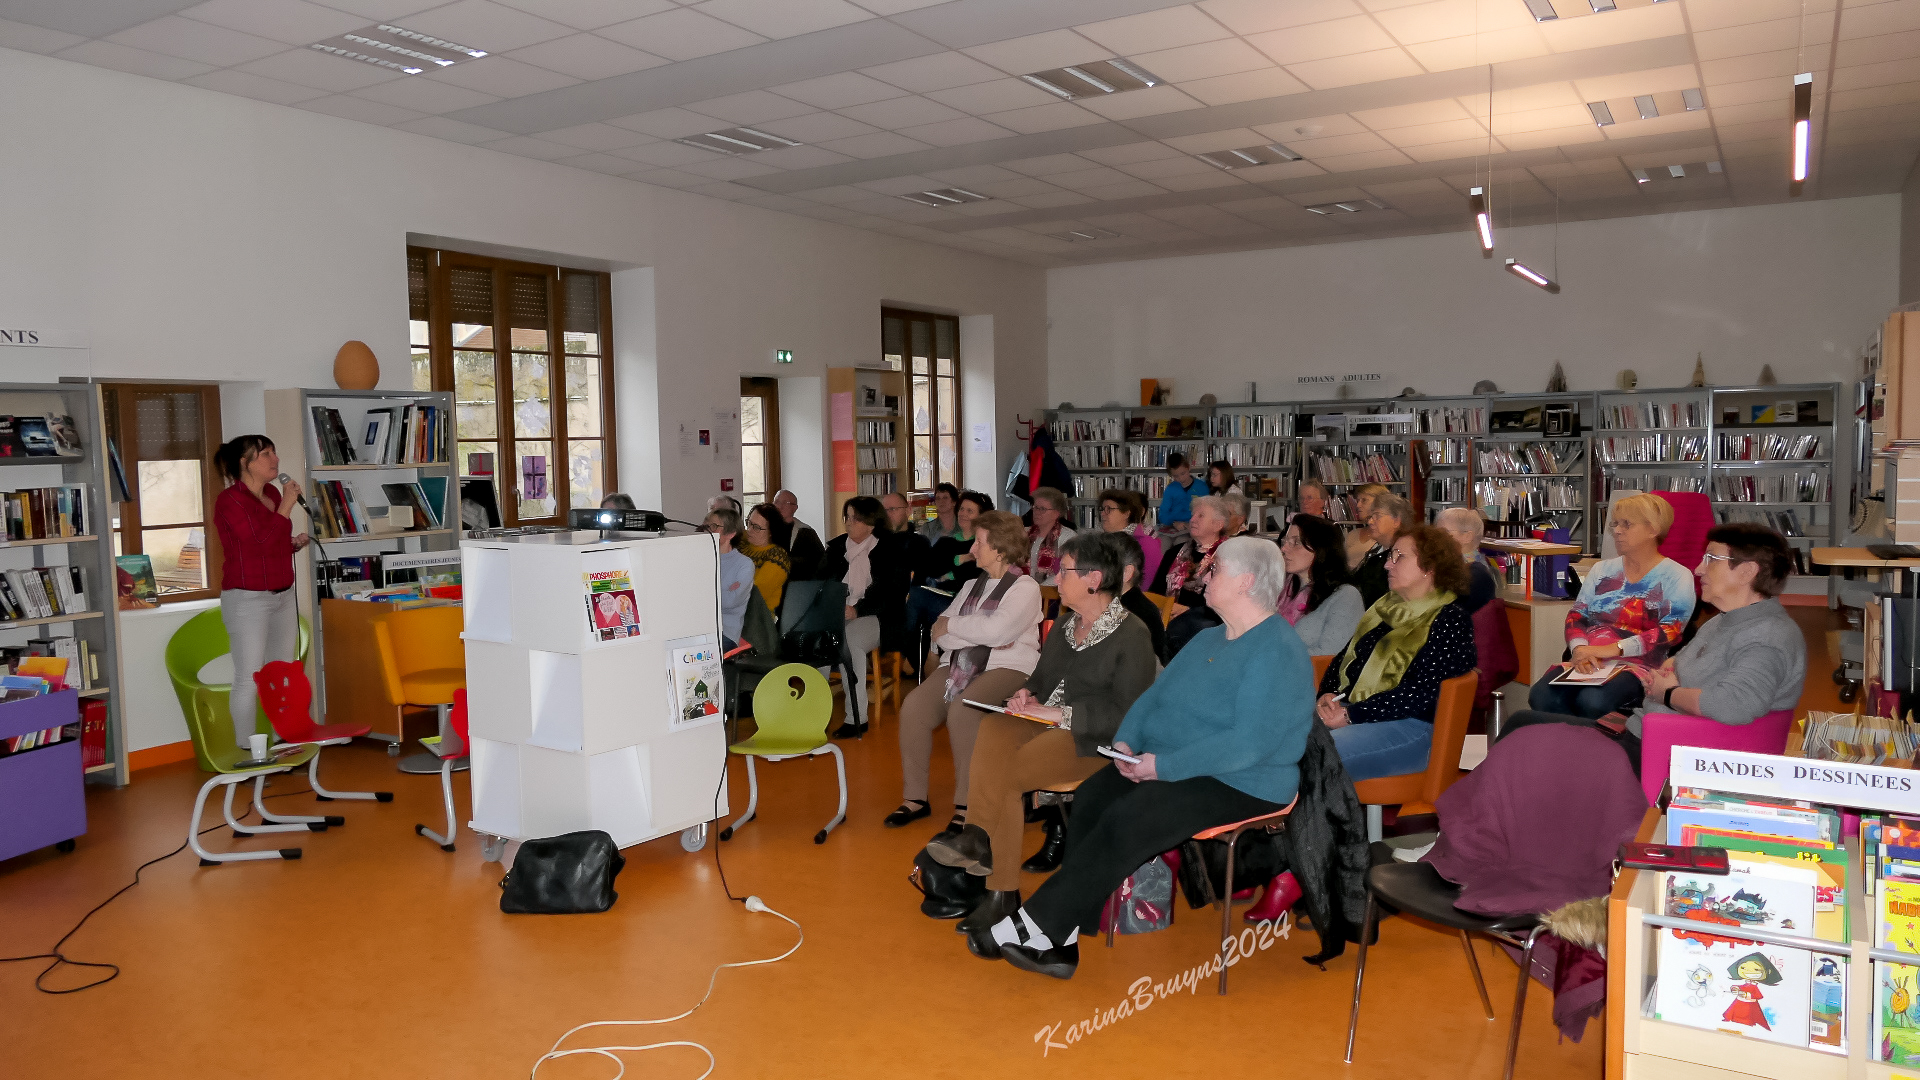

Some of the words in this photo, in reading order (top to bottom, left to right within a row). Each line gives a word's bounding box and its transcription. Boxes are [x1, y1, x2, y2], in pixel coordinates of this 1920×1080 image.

[1297, 375, 1335, 383] ROMANS
[1341, 373, 1381, 382] ADULTES
[589, 570, 623, 581] PHOSPHORE
[1694, 758, 1775, 780] BANDES
[1793, 765, 1912, 792] DESSINEES
